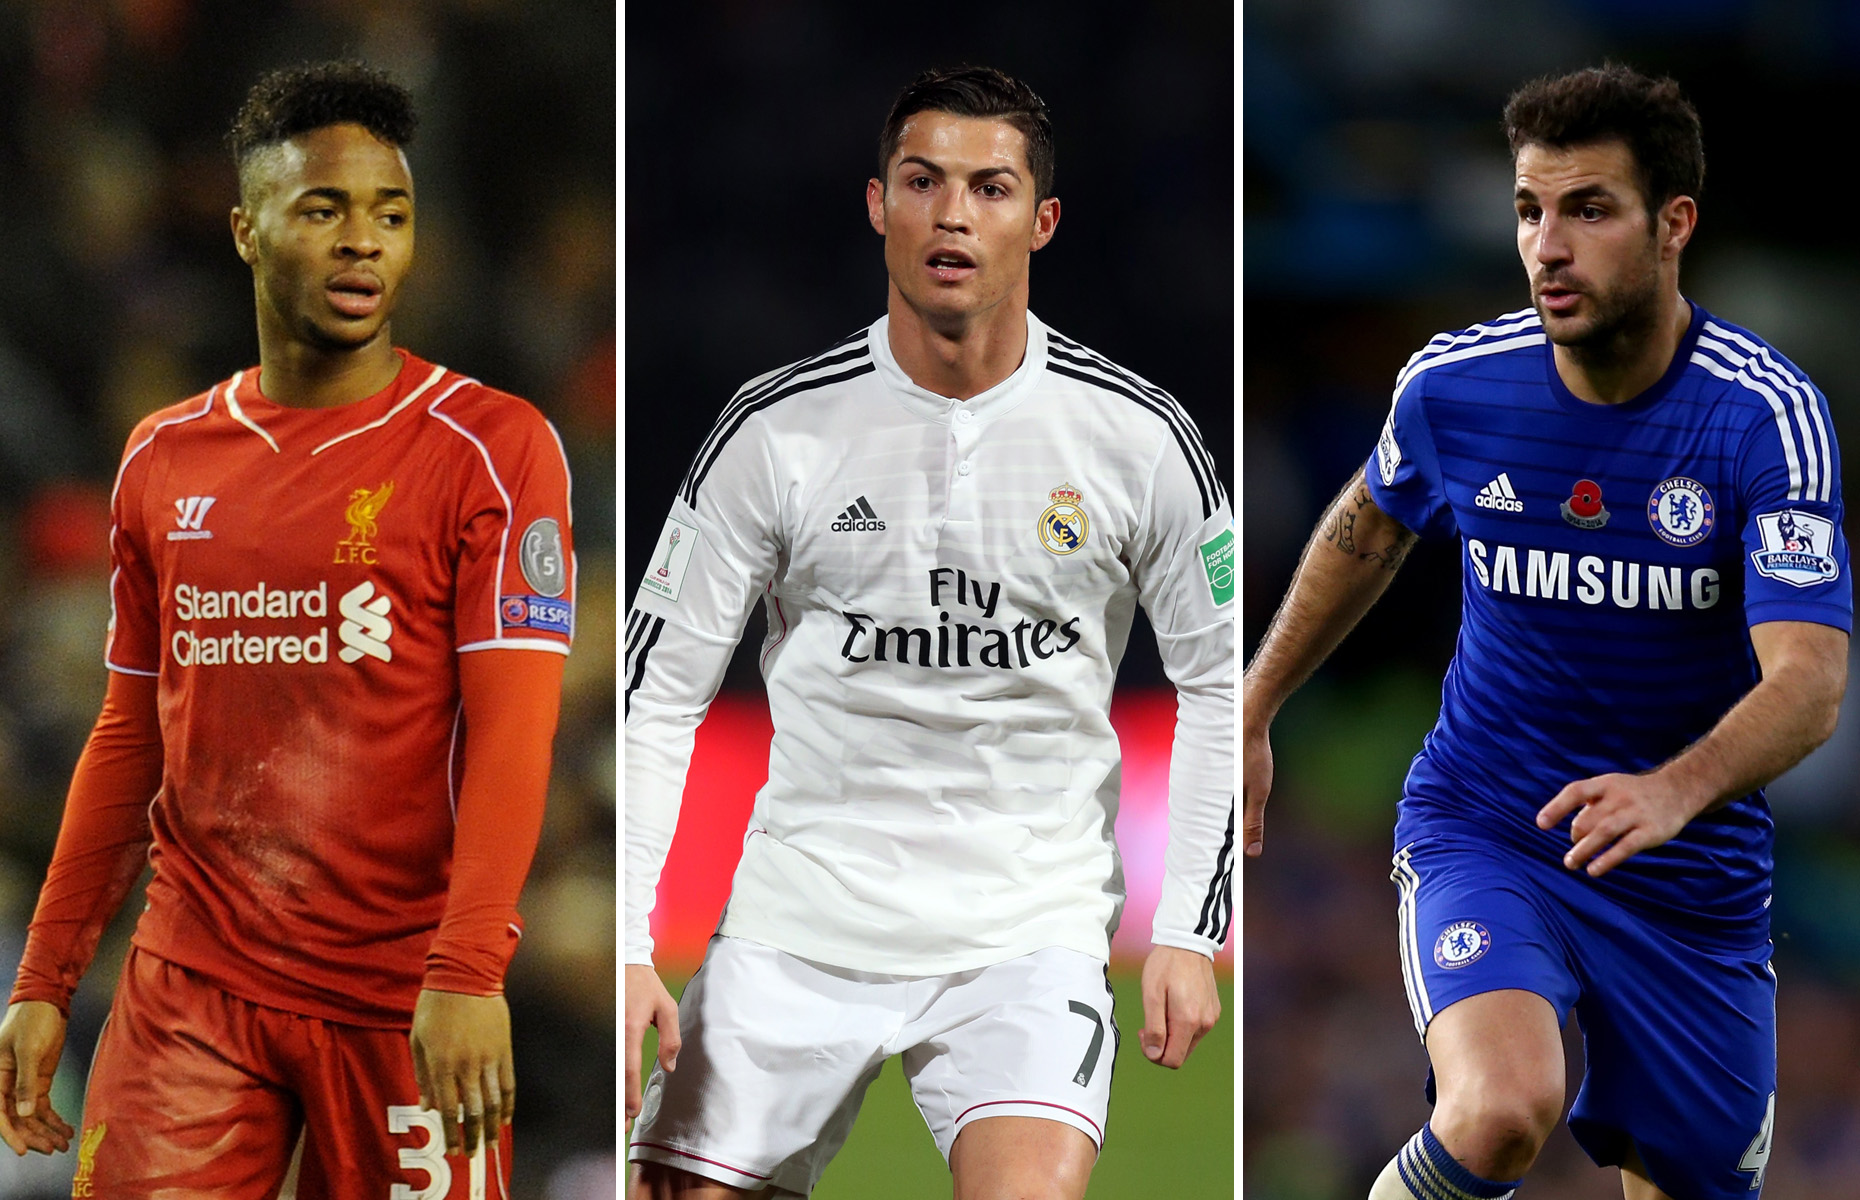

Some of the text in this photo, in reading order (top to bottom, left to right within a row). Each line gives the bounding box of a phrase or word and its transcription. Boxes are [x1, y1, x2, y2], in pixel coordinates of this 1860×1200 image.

[1660, 480, 1703, 496] CHELSEA
[1475, 492, 1523, 513] adidas
[831, 518, 886, 532] adidas
[1658, 528, 1703, 543] FOOTBALL CLUB
[543, 556, 556, 576] 5
[1208, 556, 1223, 569] FOR
[1767, 554, 1817, 566] BARCLAYS
[1468, 538, 1720, 611] SAMSUNG
[174, 581, 327, 621] Standard
[929, 567, 1001, 619] Fly
[171, 630, 328, 667] Chartered
[841, 610, 1081, 669] Emirates
[1440, 922, 1477, 941] CHELSEA
[1067, 999, 1105, 1088] 7
[1736, 1090, 1776, 1190] 4
